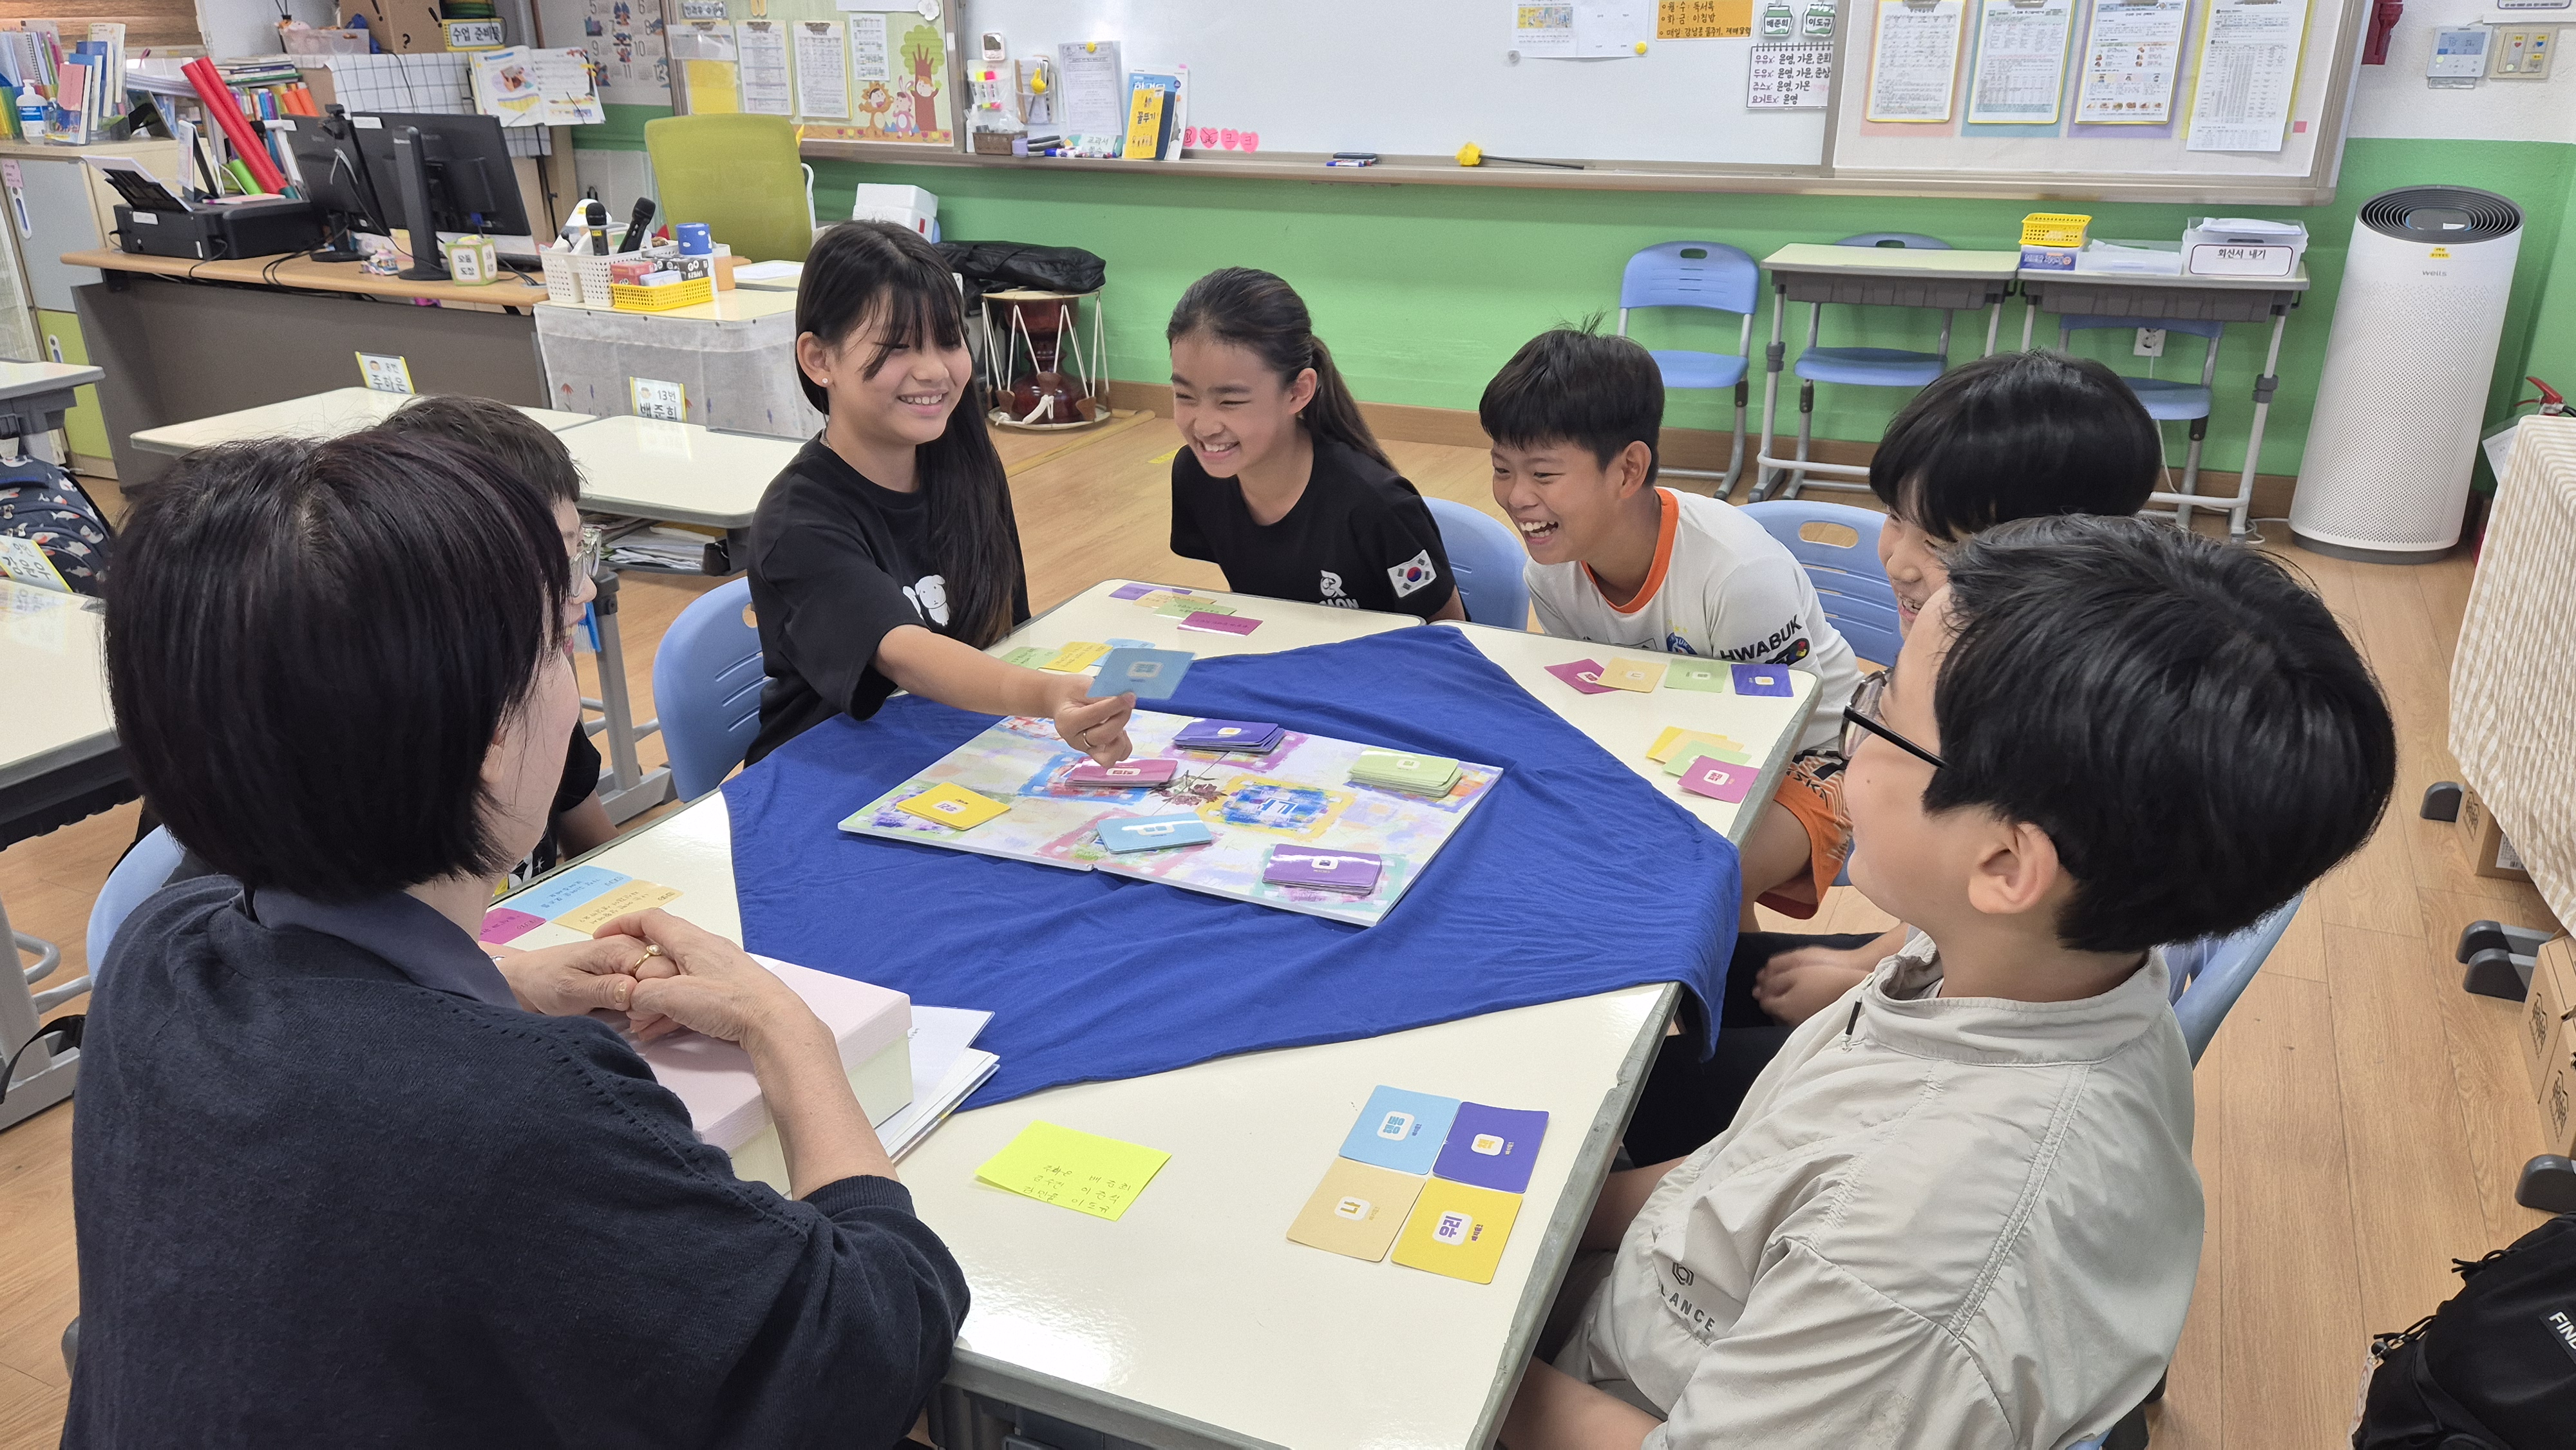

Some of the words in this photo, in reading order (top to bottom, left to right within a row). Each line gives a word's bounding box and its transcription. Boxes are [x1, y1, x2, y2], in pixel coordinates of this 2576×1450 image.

[1693, 13, 1716, 23] 아침밥
[1766, 19, 1788, 28] 배준희
[1808, 18, 1832, 27] 이도규
[453, 26, 471, 42] 수업
[592, 40, 600, 56] 9
[634, 40, 646, 57] 10
[1817, 53, 1832, 64] 준희
[1815, 67, 1832, 79] 준상
[1783, 93, 1798, 105] 윤영
[2217, 249, 2244, 259] 회신서
[2249, 249, 2266, 259] 내기
[372, 375, 407, 392] 주하은
[657, 390, 676, 403] 13번
[1719, 614, 1804, 661] HWABUK
[936, 802, 958, 812] 우리
[1383, 1116, 1406, 1135] 행동
[1072, 1198, 1110, 1214] 이도규
[1340, 1200, 1361, 1215] 나
[1438, 1214, 1463, 1239] 우리
